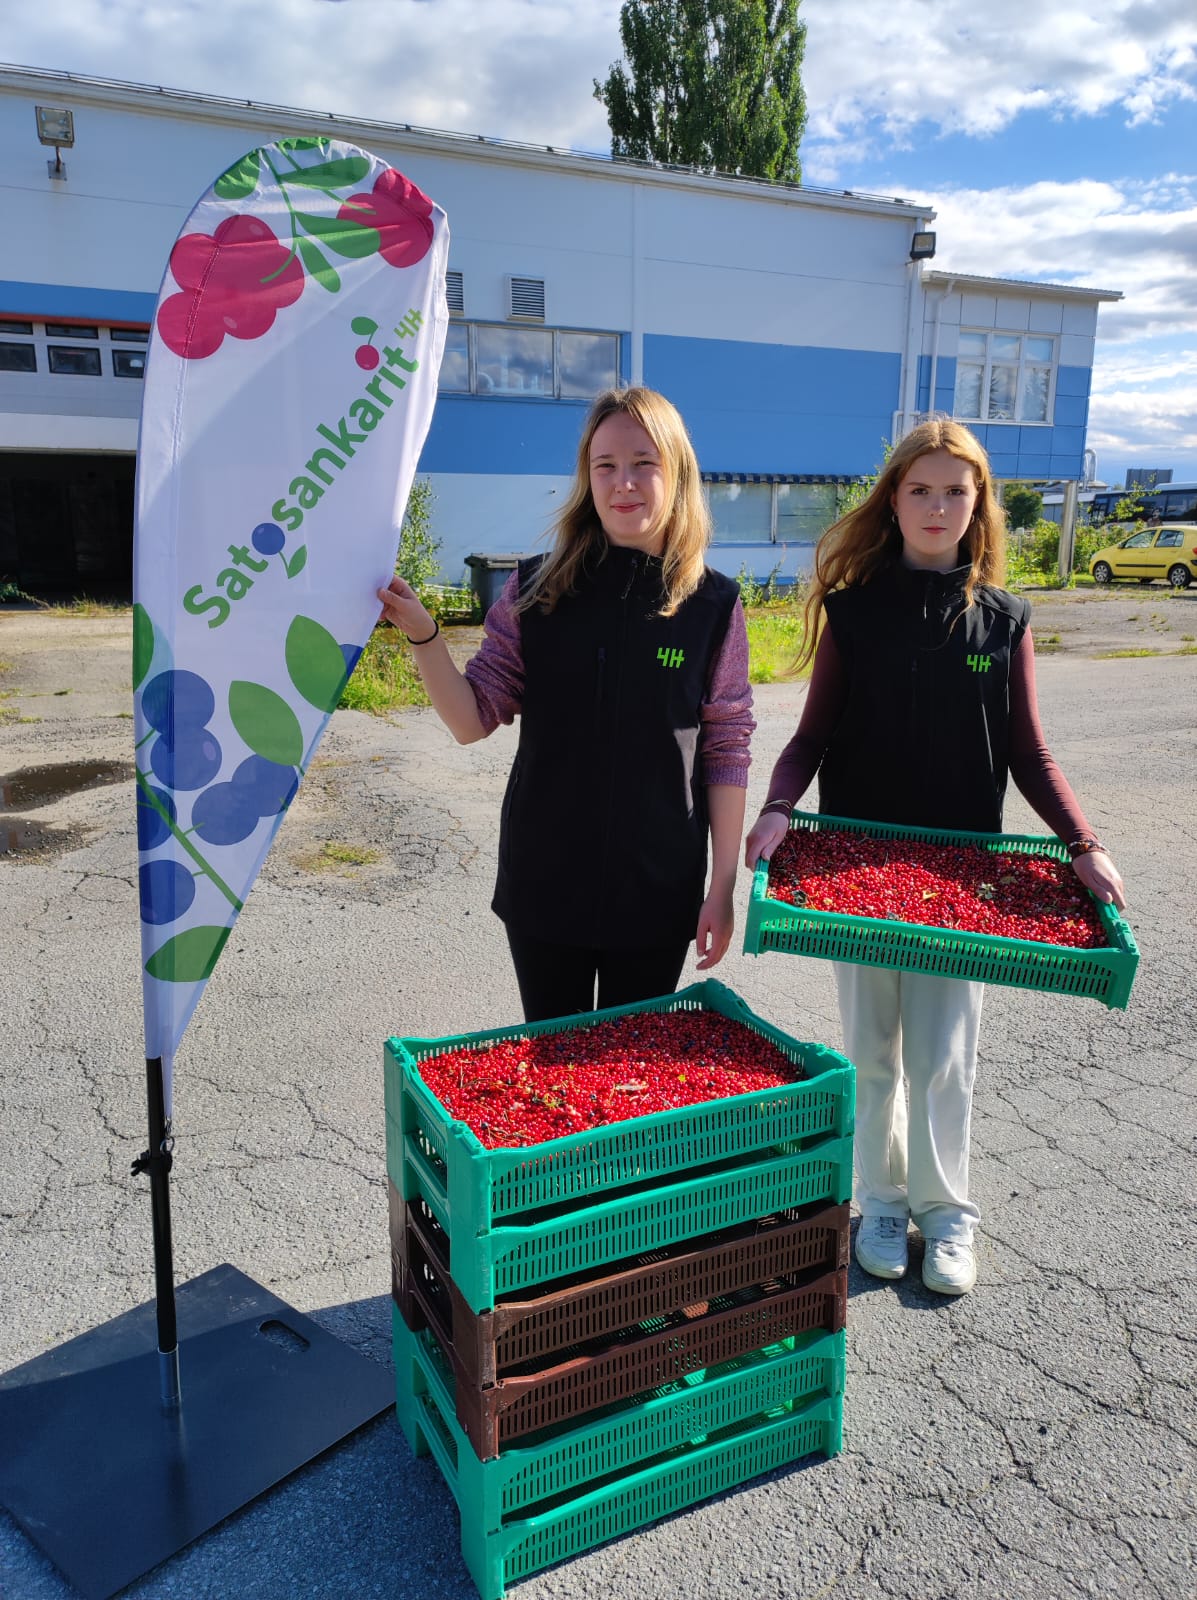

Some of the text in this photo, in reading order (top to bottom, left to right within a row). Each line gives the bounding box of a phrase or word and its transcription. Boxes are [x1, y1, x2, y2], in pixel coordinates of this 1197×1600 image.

[394, 309, 424, 339] 4H
[657, 647, 685, 669] 4H
[966, 654, 992, 673] 4H
